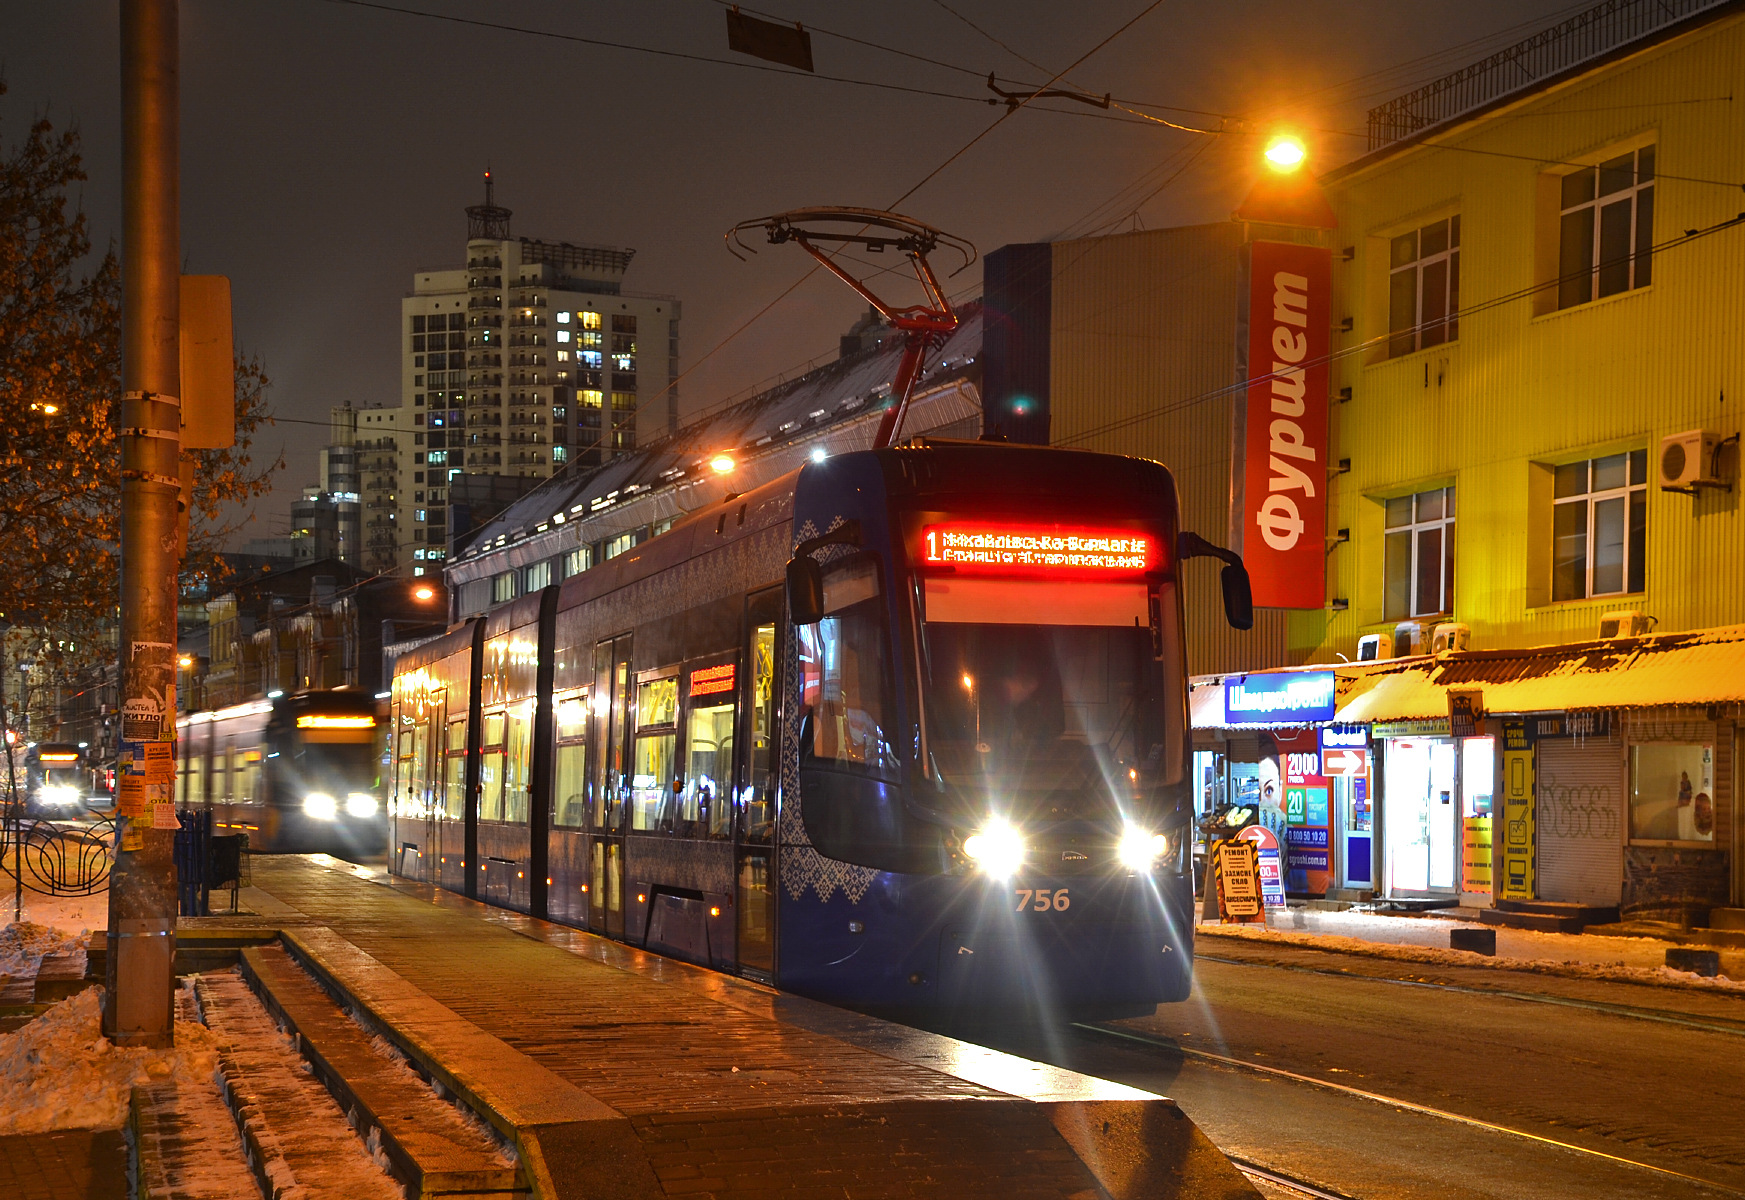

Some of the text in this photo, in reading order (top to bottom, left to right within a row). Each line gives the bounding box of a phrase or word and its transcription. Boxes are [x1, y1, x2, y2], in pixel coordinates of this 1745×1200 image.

[1257, 271, 1316, 551] Фуршет
[926, 532, 941, 561] 1
[123, 713, 160, 721] ЖИТЛО
[1568, 718, 1595, 733] COFFEE
[1452, 725, 1475, 736] COFFEE
[1287, 752, 1318, 776] 2000
[1288, 791, 1303, 814] 20
[1288, 830, 1327, 841] 0 800 50 10 20
[1289, 854, 1327, 867] sgroshi.com.ua
[1015, 888, 1070, 912] 756
